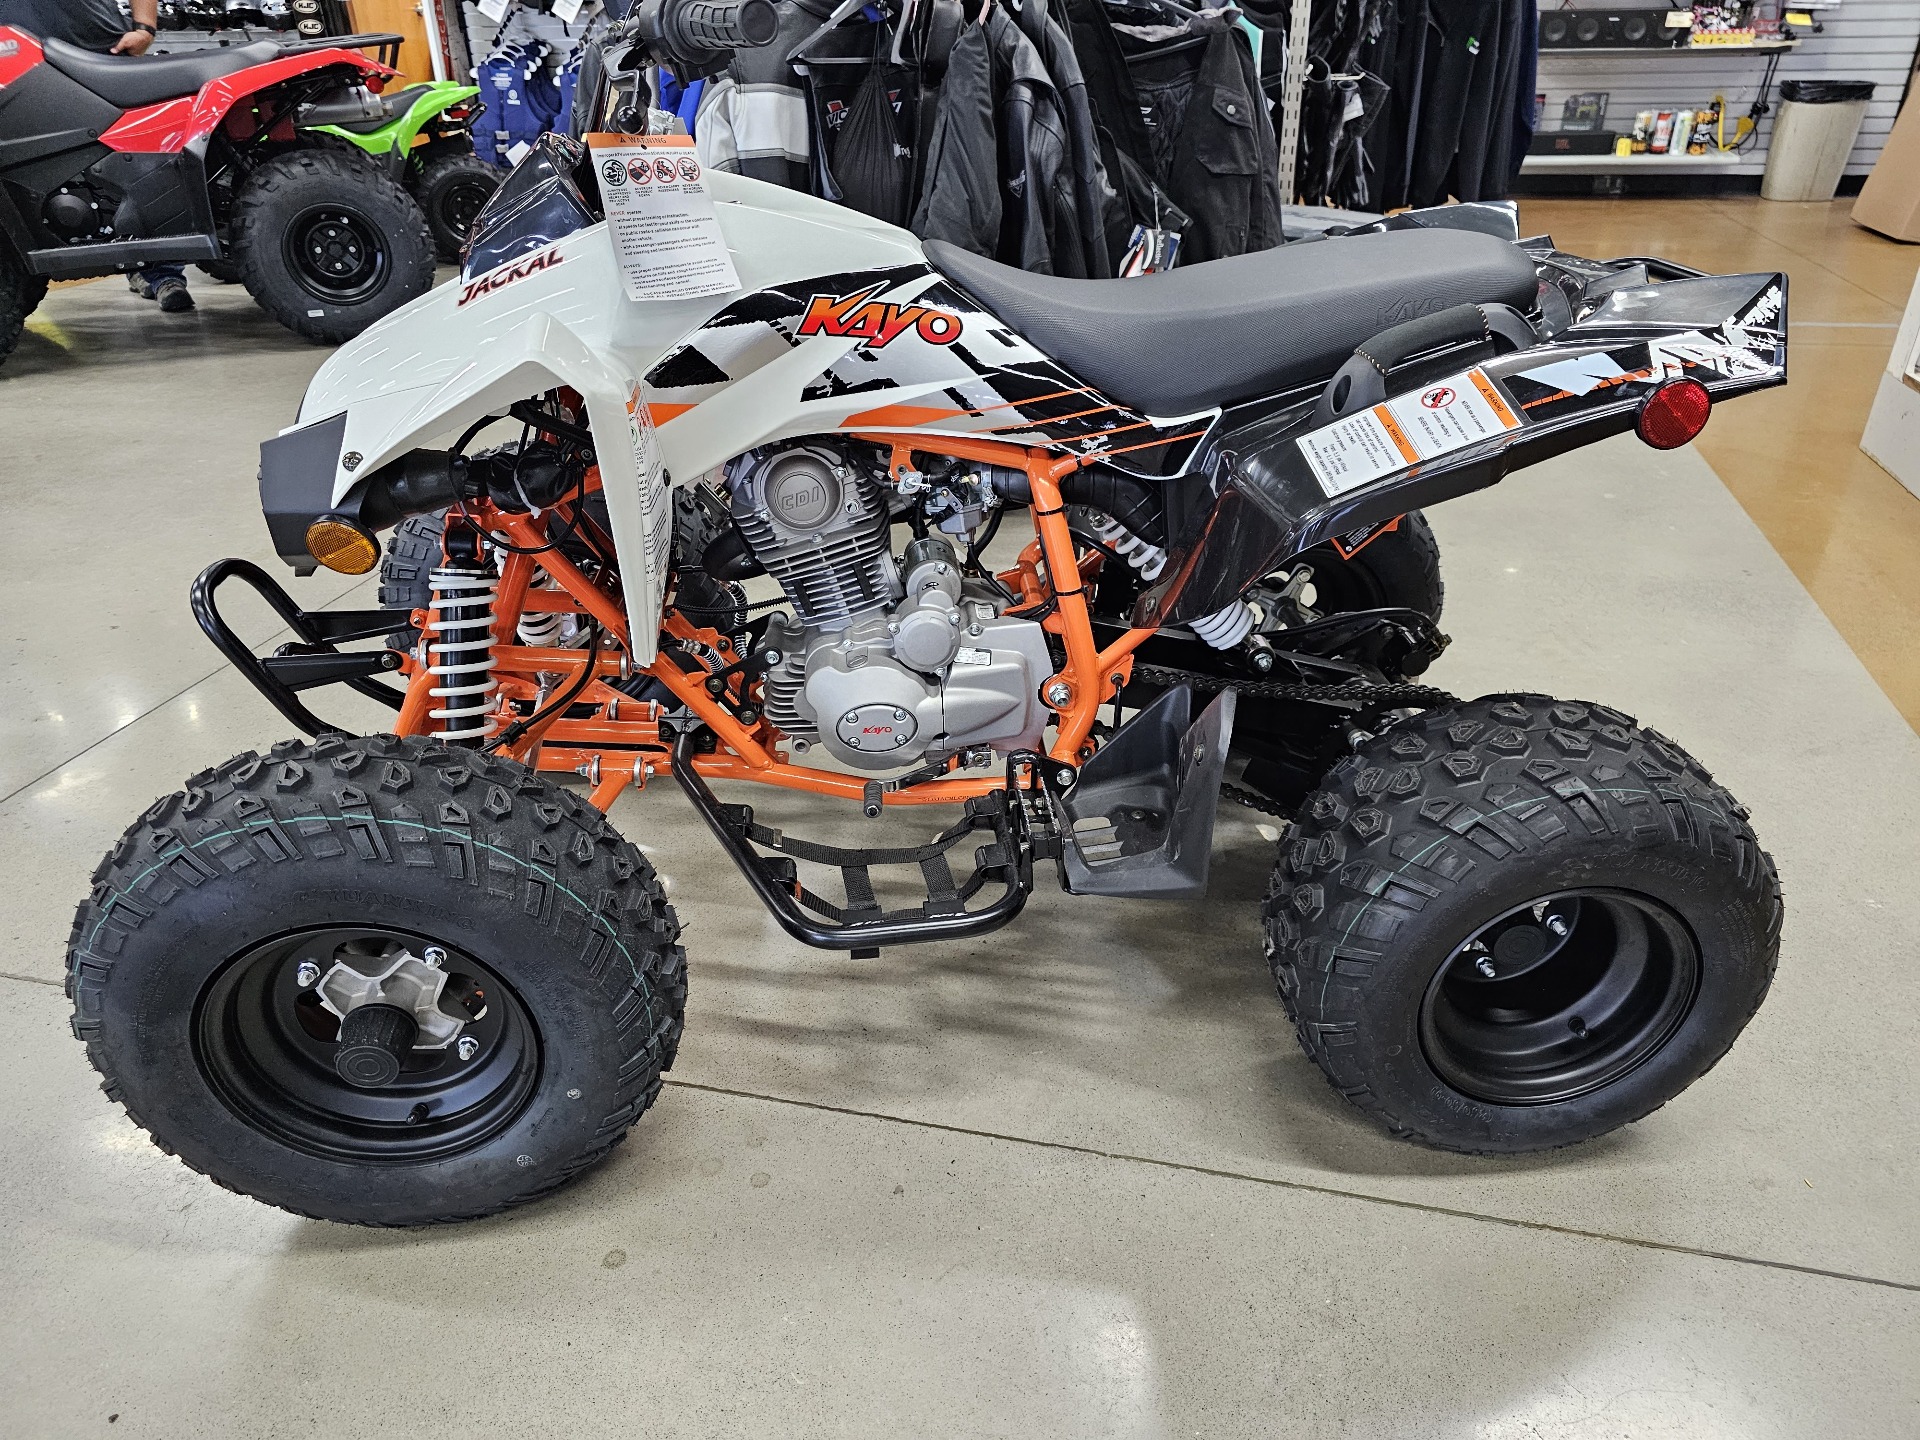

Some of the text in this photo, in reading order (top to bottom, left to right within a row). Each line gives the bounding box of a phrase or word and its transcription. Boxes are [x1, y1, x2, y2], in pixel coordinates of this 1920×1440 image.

[1155, 234, 1168, 264] Reflective
[458, 246, 564, 306] JACKAL
[796, 280, 963, 348] KAYO
[782, 486, 820, 511] CDI
[863, 725, 892, 734] KAYO
